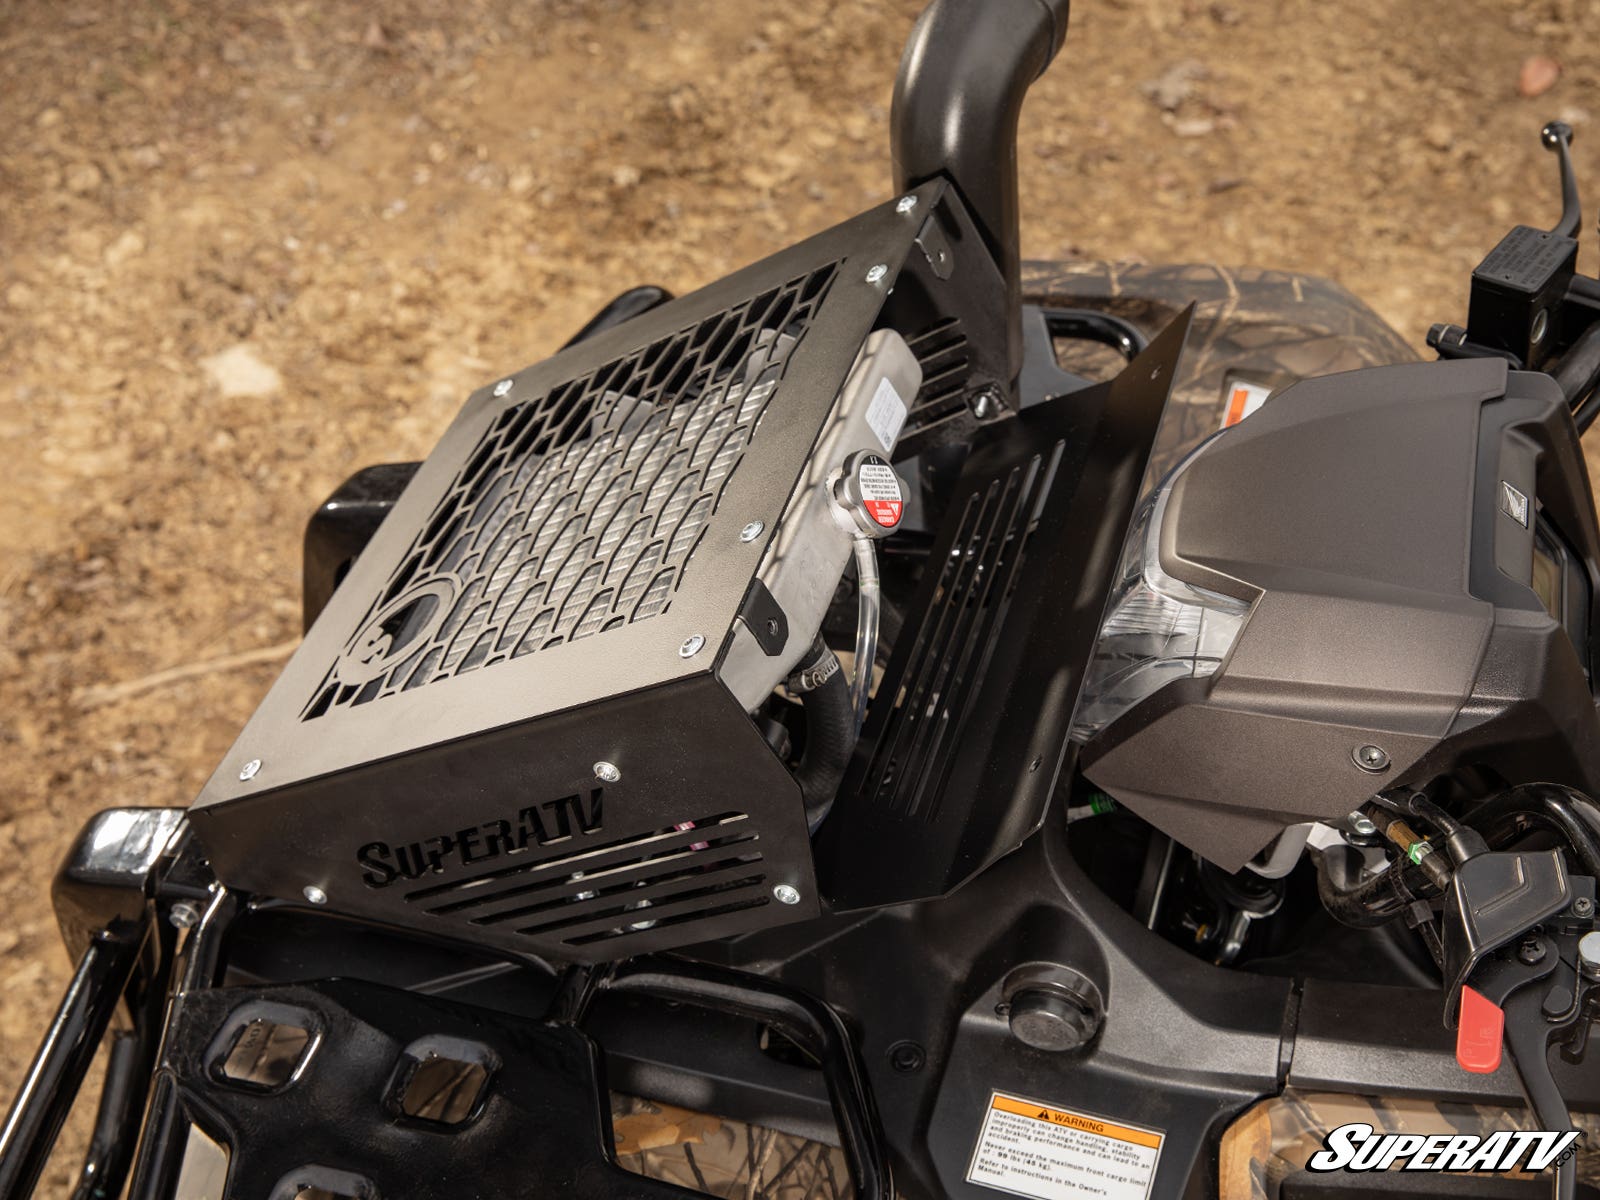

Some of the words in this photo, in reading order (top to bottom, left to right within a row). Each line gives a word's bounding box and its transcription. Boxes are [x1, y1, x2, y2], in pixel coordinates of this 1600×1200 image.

[992, 1118, 1030, 1132] improperly
[1048, 1132, 1072, 1143] change
[1112, 1148, 1140, 1160] stability
[994, 1111, 1035, 1127] Overloading
[1039, 1123, 1051, 1131] this
[1080, 1134, 1110, 1146] carrying
[1112, 1142, 1133, 1151] cargo
[1054, 1113, 1104, 1132] WARNING
[985, 1140, 1005, 1150] Never
[1008, 1148, 1033, 1158] exceed
[1050, 1158, 1084, 1172] maximum
[1086, 1167, 1104, 1177] front
[1106, 1174, 1127, 1183] cargo
[1130, 1178, 1147, 1187] limit
[998, 1151, 1008, 1159] 99
[1010, 1154, 1020, 1162] lbs
[1005, 1128, 1031, 1140] braking
[1034, 1137, 1080, 1152] performance
[1082, 1148, 1096, 1156] and
[1114, 1156, 1129, 1164] lead
[980, 1158, 999, 1167] Refer
[1011, 1167, 1053, 1182] instructions
[1064, 1180, 1076, 1188] the
[1078, 1183, 1107, 1196] Owner's
